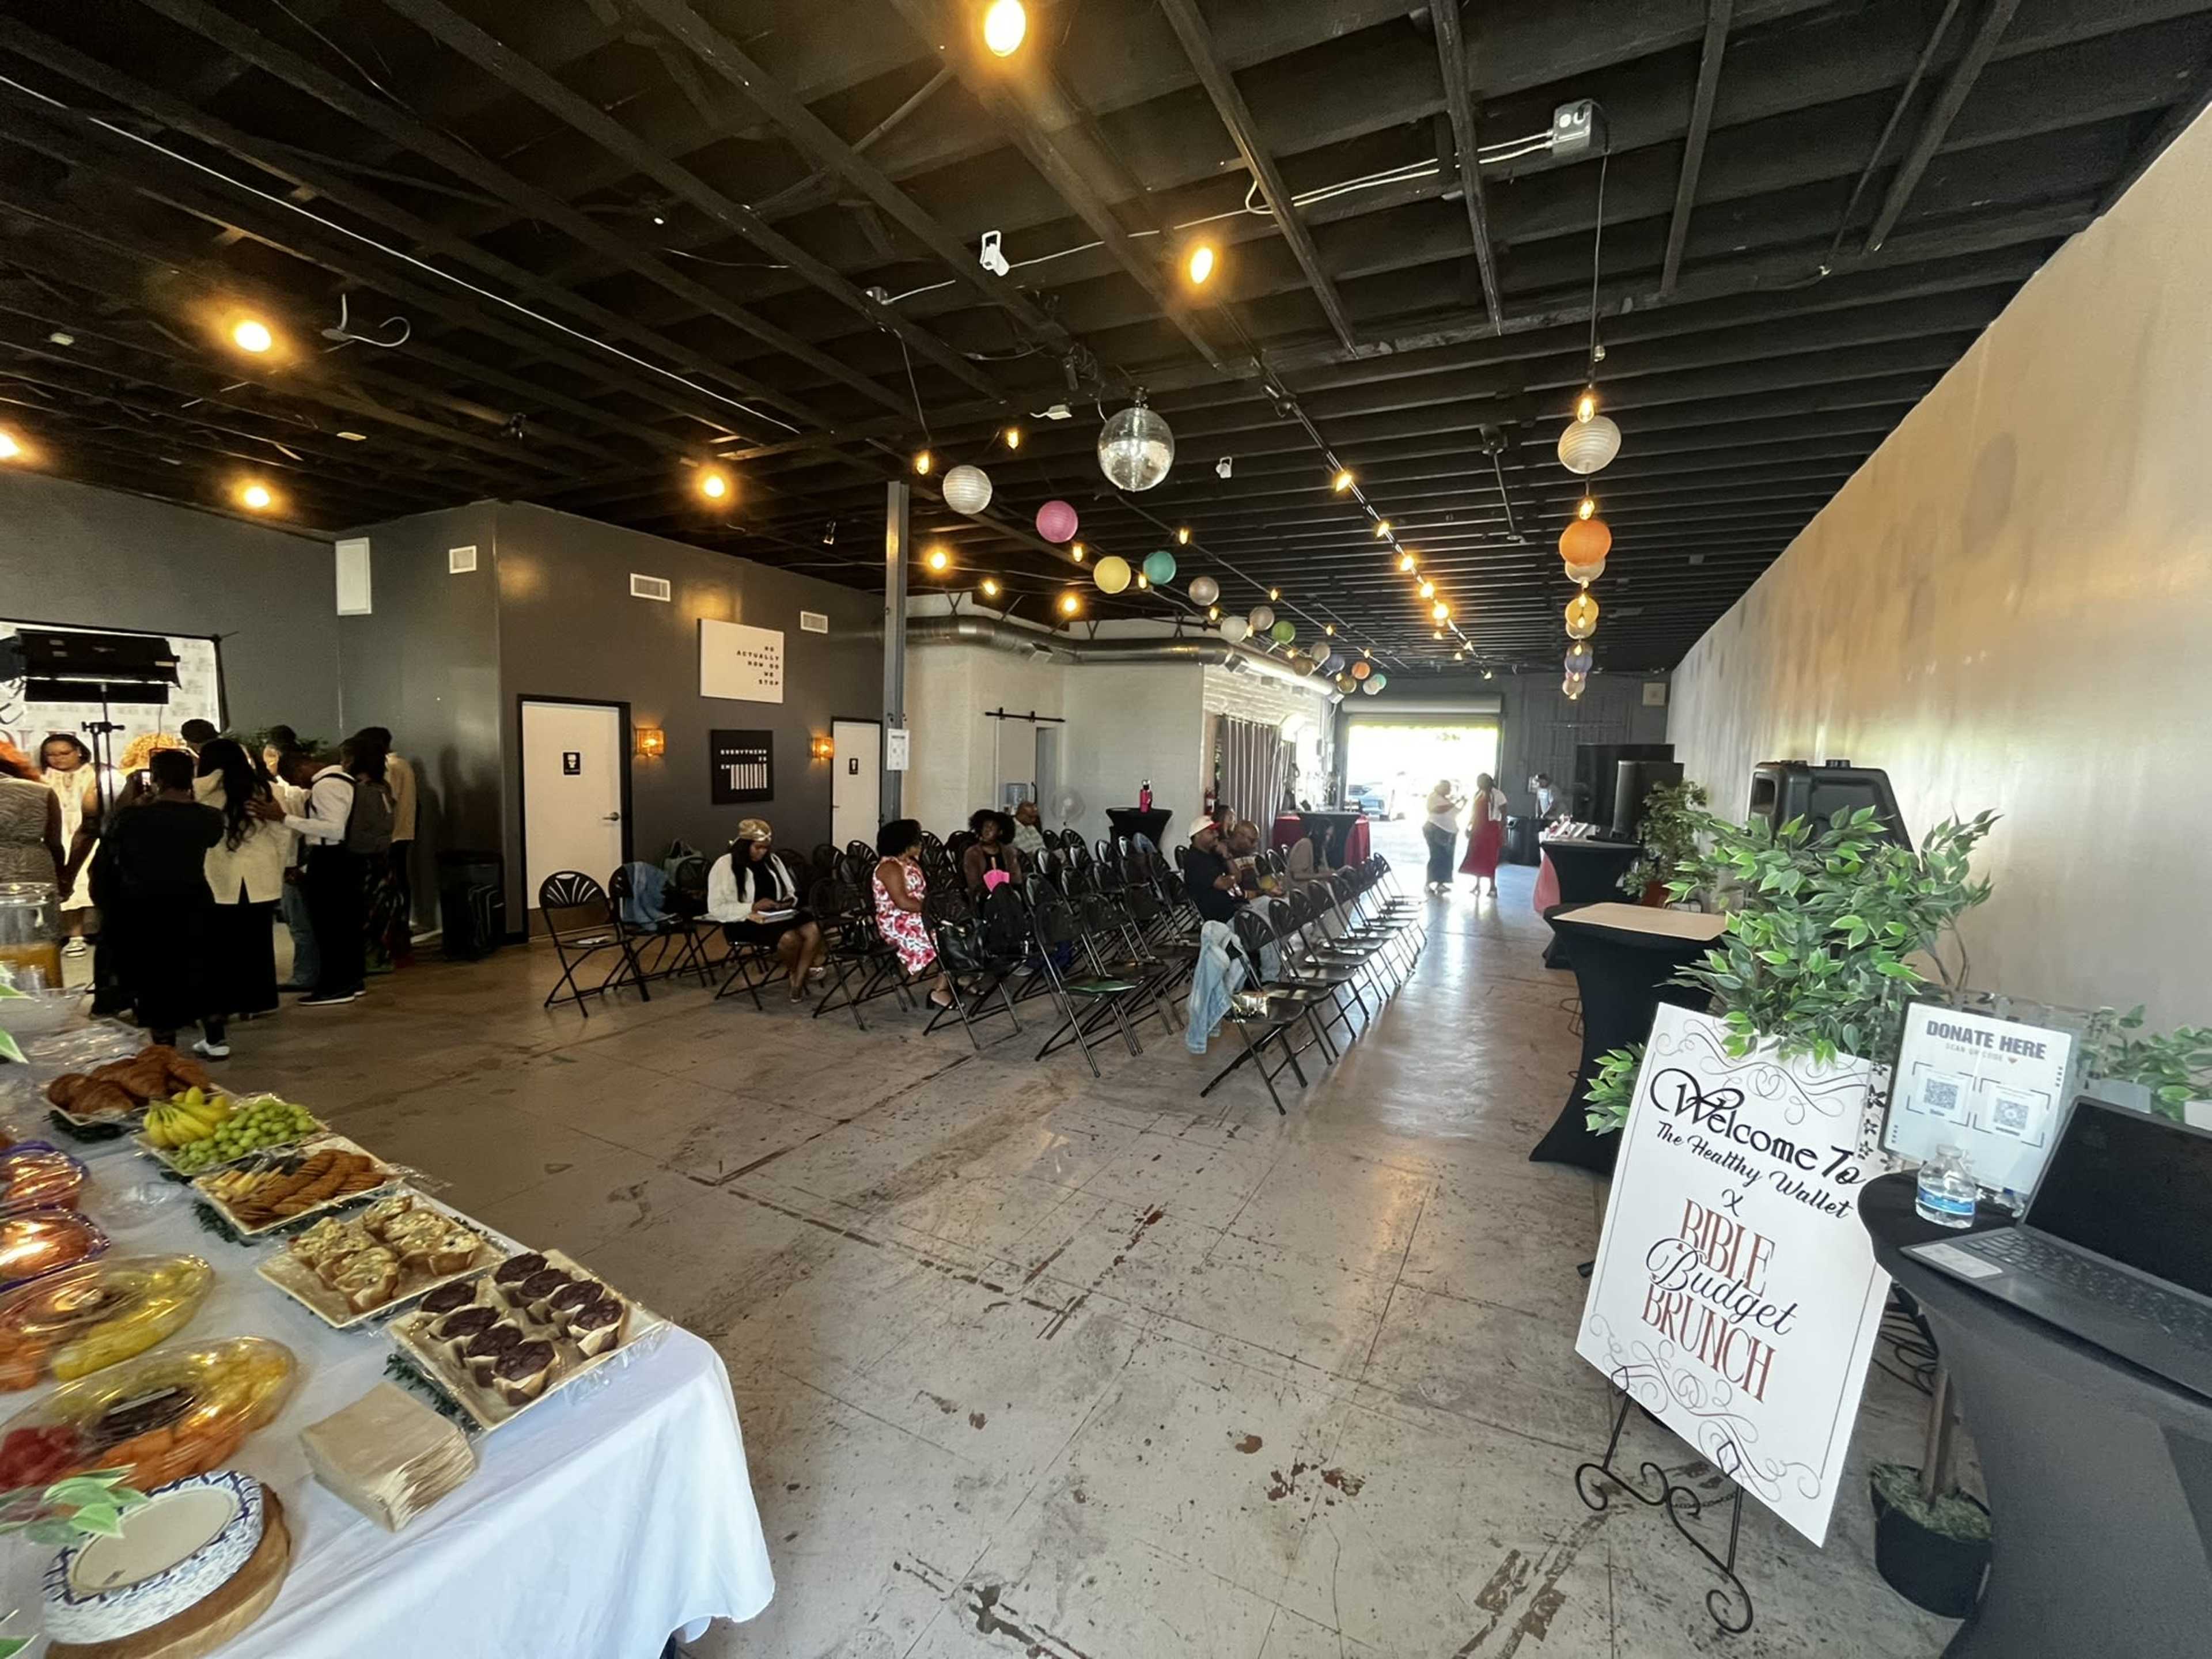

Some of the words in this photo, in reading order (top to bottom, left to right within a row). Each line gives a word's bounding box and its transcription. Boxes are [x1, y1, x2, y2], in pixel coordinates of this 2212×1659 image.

[736, 650, 779, 661] ACTUALLY
[1926, 1020, 1994, 1048] DONATE
[1999, 1035, 2047, 1060] HERE
[1650, 1067, 1818, 1172] Welcome
[1821, 1144, 1866, 1185] To
[1656, 1120, 1685, 1147] The
[1687, 1134, 1763, 1190] Healthy
[1769, 1170, 1854, 1219] Wallet
[1646, 1237, 1798, 1336] Budget
[1676, 1198, 1776, 1298] BIBLE
[1641, 1283, 1777, 1404] BRUNCH
